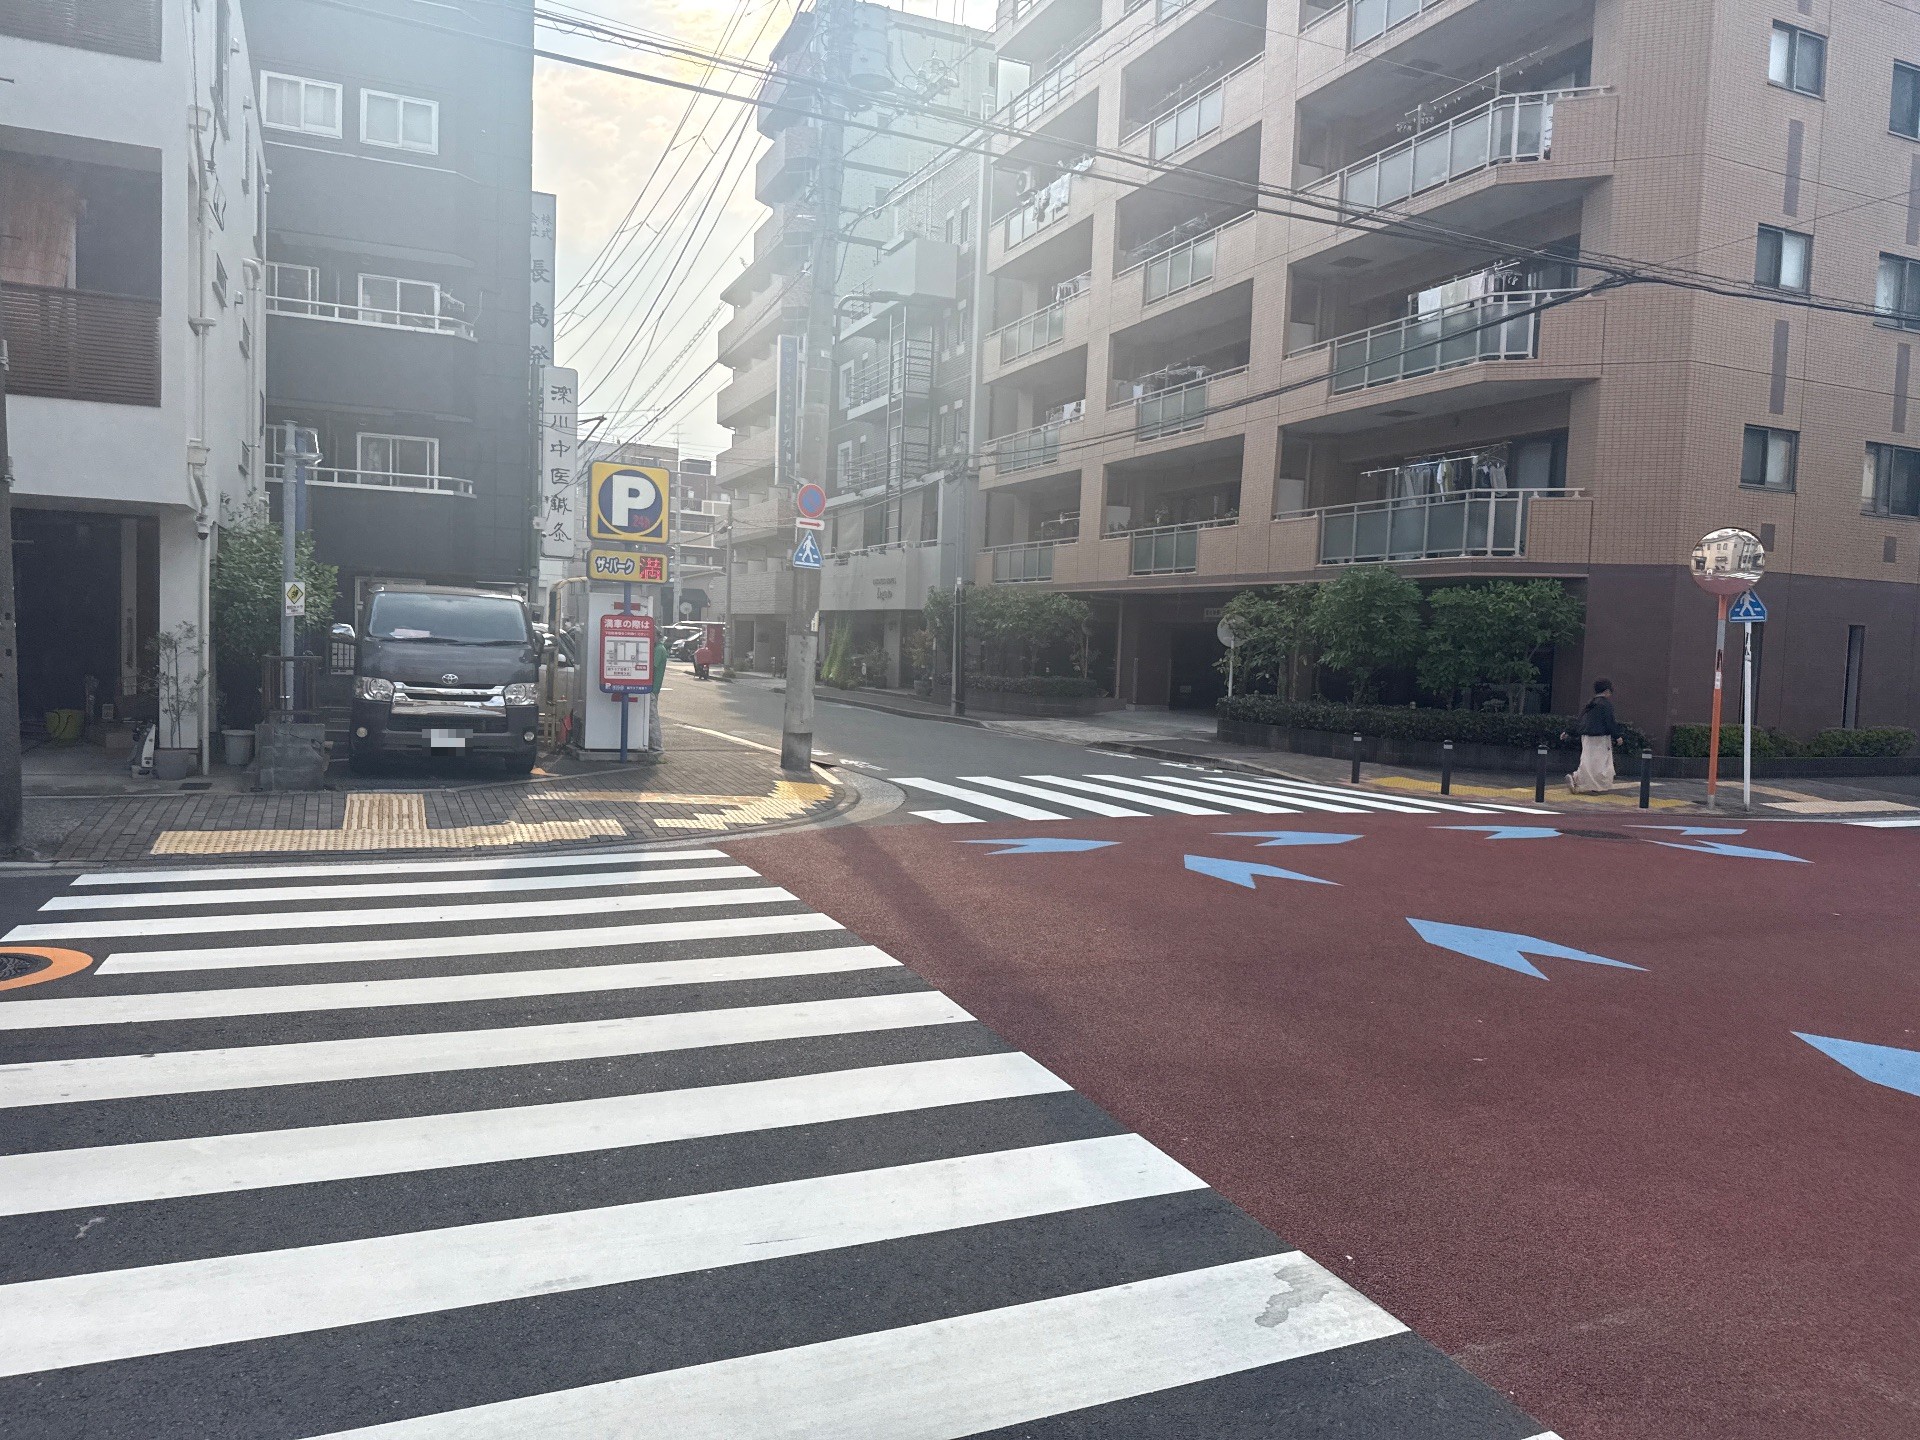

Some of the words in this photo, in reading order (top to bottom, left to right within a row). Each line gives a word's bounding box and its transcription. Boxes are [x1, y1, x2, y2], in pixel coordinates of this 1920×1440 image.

[611, 474, 656, 527] P
[639, 556, 662, 581] 満
[604, 618, 650, 630] 満車の際は
